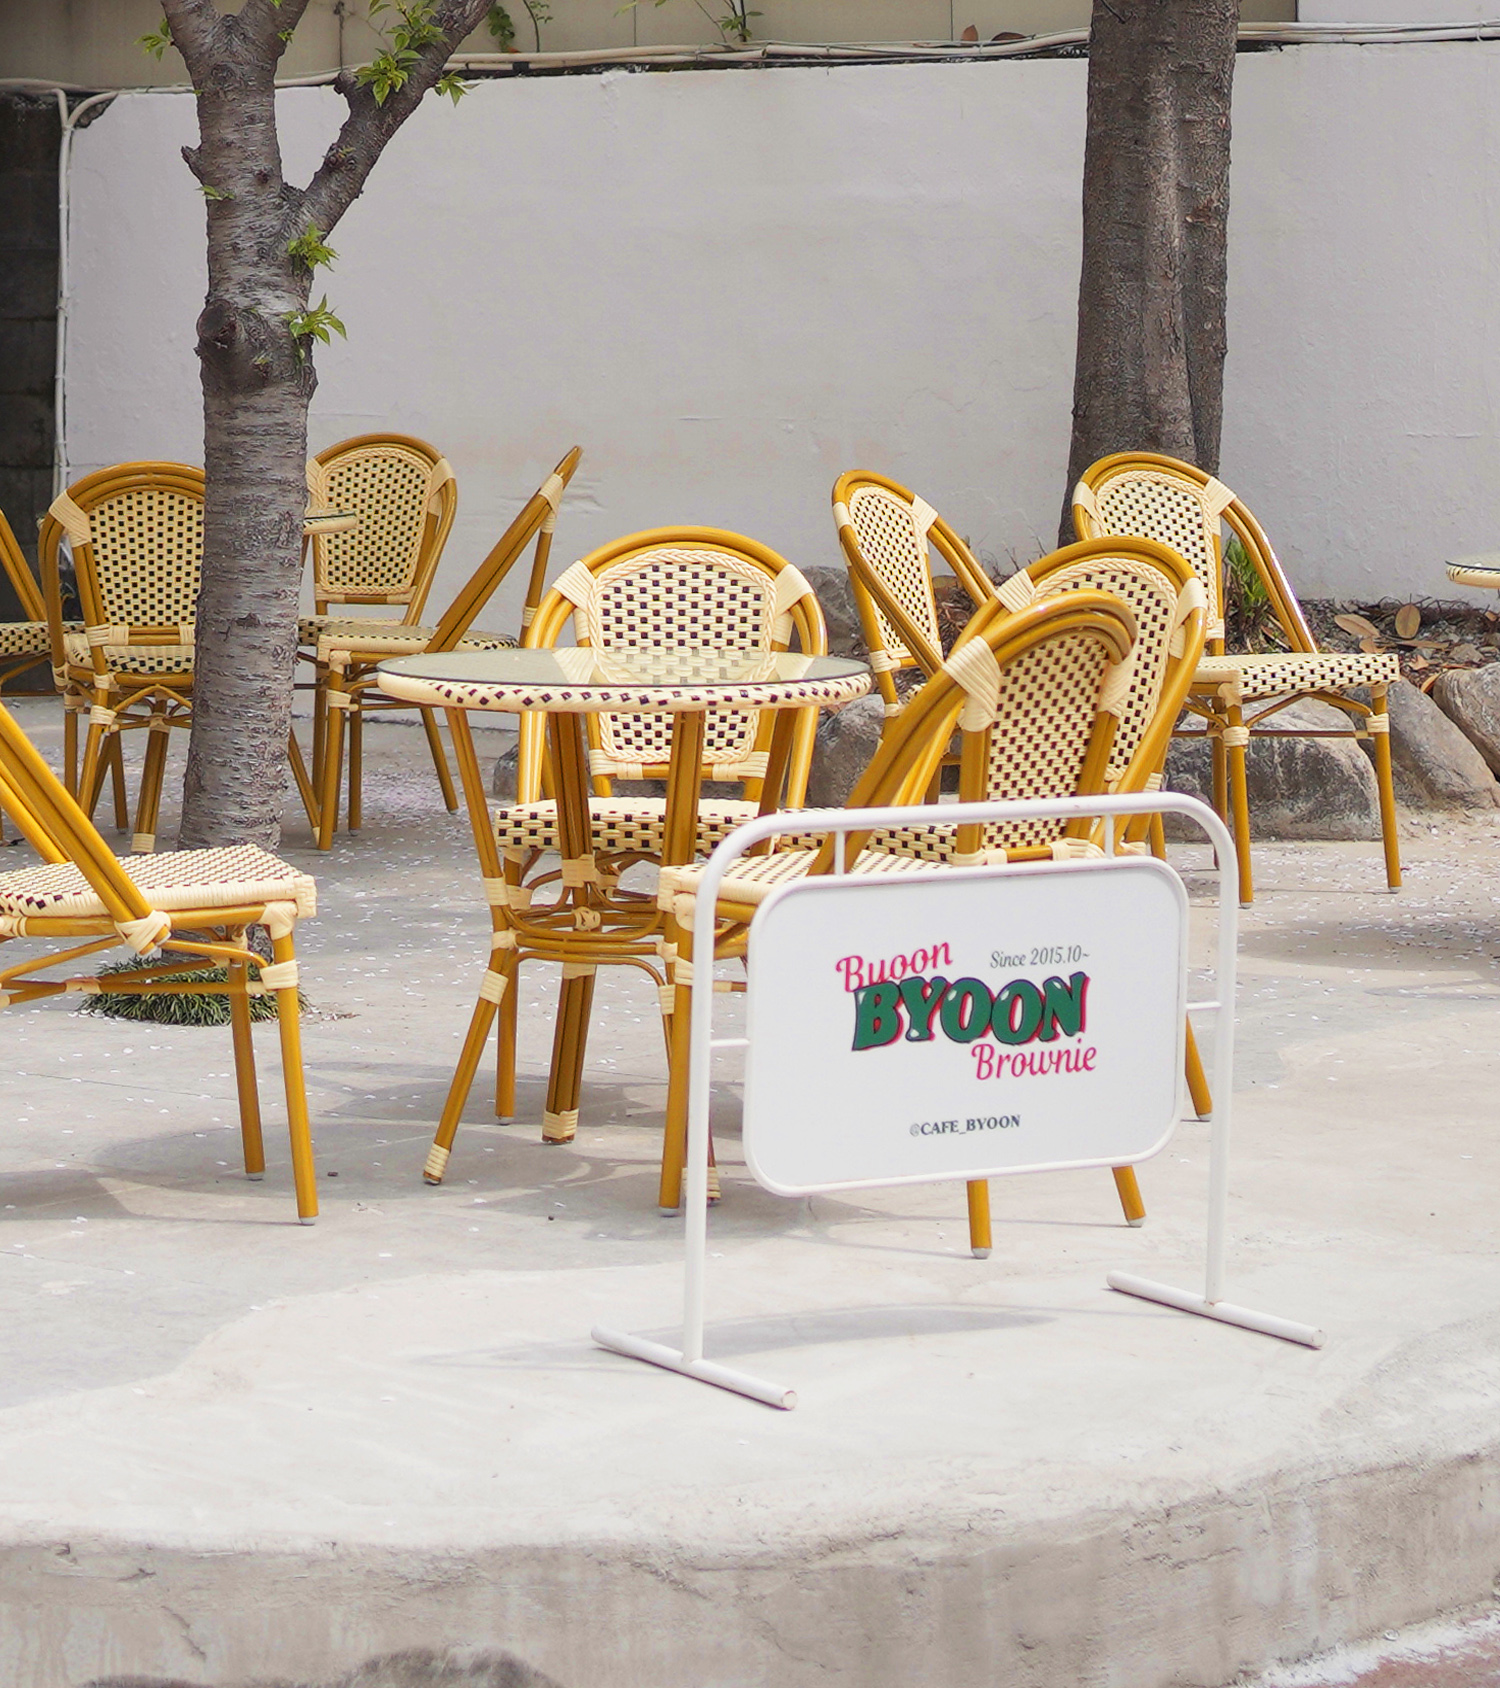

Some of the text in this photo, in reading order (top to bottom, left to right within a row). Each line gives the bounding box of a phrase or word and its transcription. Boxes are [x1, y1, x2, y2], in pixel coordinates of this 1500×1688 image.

[990, 950, 1027, 969] Since
[851, 971, 1091, 1051] BYOON
[970, 1038, 1098, 1081] Brownie
[909, 1114, 1021, 1137] @CAFE_BYOON
